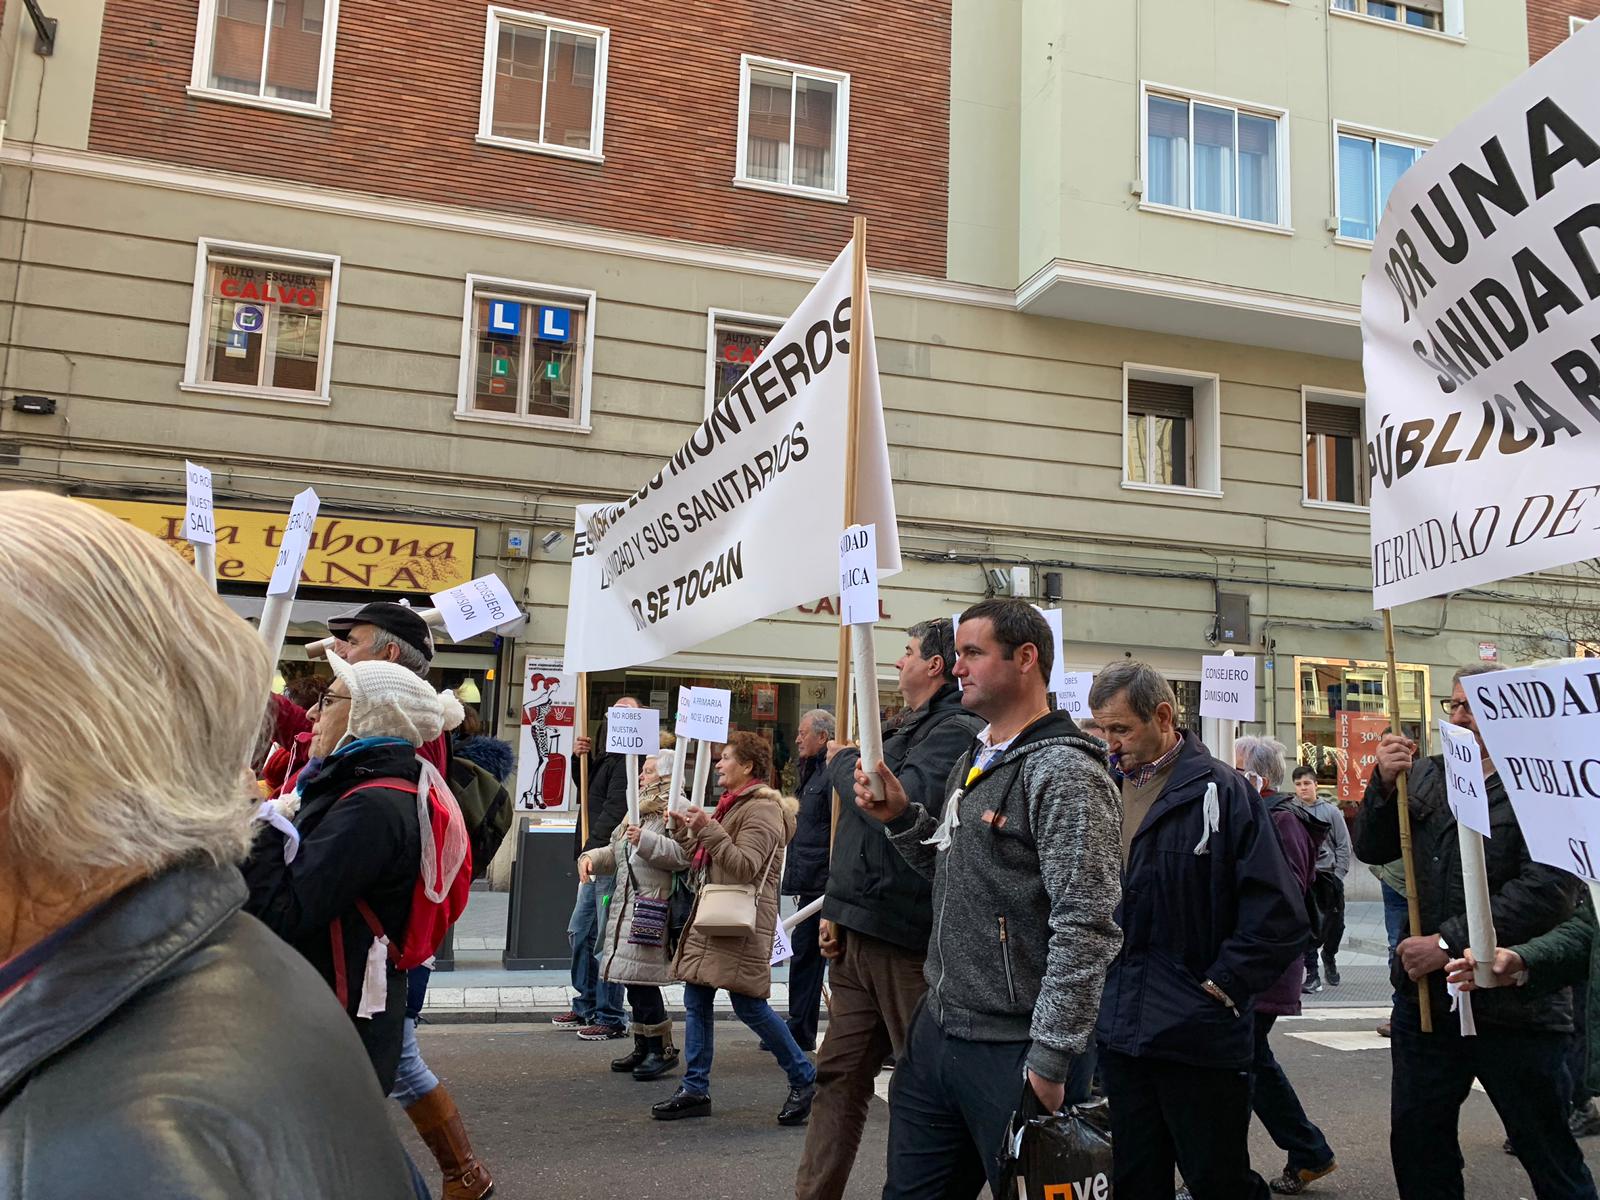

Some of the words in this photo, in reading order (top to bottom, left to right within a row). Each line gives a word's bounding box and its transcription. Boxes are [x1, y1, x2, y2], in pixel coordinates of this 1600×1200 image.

[1410, 96, 1600, 265] UNA
[222, 265, 254, 279] AUTO
[264, 270, 317, 287] ESCUELA
[220, 277, 316, 307] CALVO
[493, 303, 515, 330] L
[543, 309, 565, 336] L
[233, 333, 242, 347] L
[723, 344, 764, 364] CA
[495, 359, 506, 375] L
[547, 363, 557, 378] L
[631, 532, 645, 560] Y
[642, 512, 680, 554] SUS
[677, 420, 809, 533] SANITARIOS
[1506, 485, 1600, 548] DE
[646, 584, 670, 624] SE
[673, 540, 743, 611] TOCAN
[473, 580, 505, 621] CONSEJERO
[1205, 668, 1249, 681] CONSEJERO
[1204, 690, 1239, 703] DIMISION
[612, 711, 621, 719] NO
[622, 712, 642, 720] ROBES
[702, 714, 725, 725] VENDE
[611, 725, 638, 734] NUESTRA
[611, 735, 643, 748] SALUD
[1341, 714, 1350, 797] REBAJAS
[1568, 837, 1597, 880] SI
